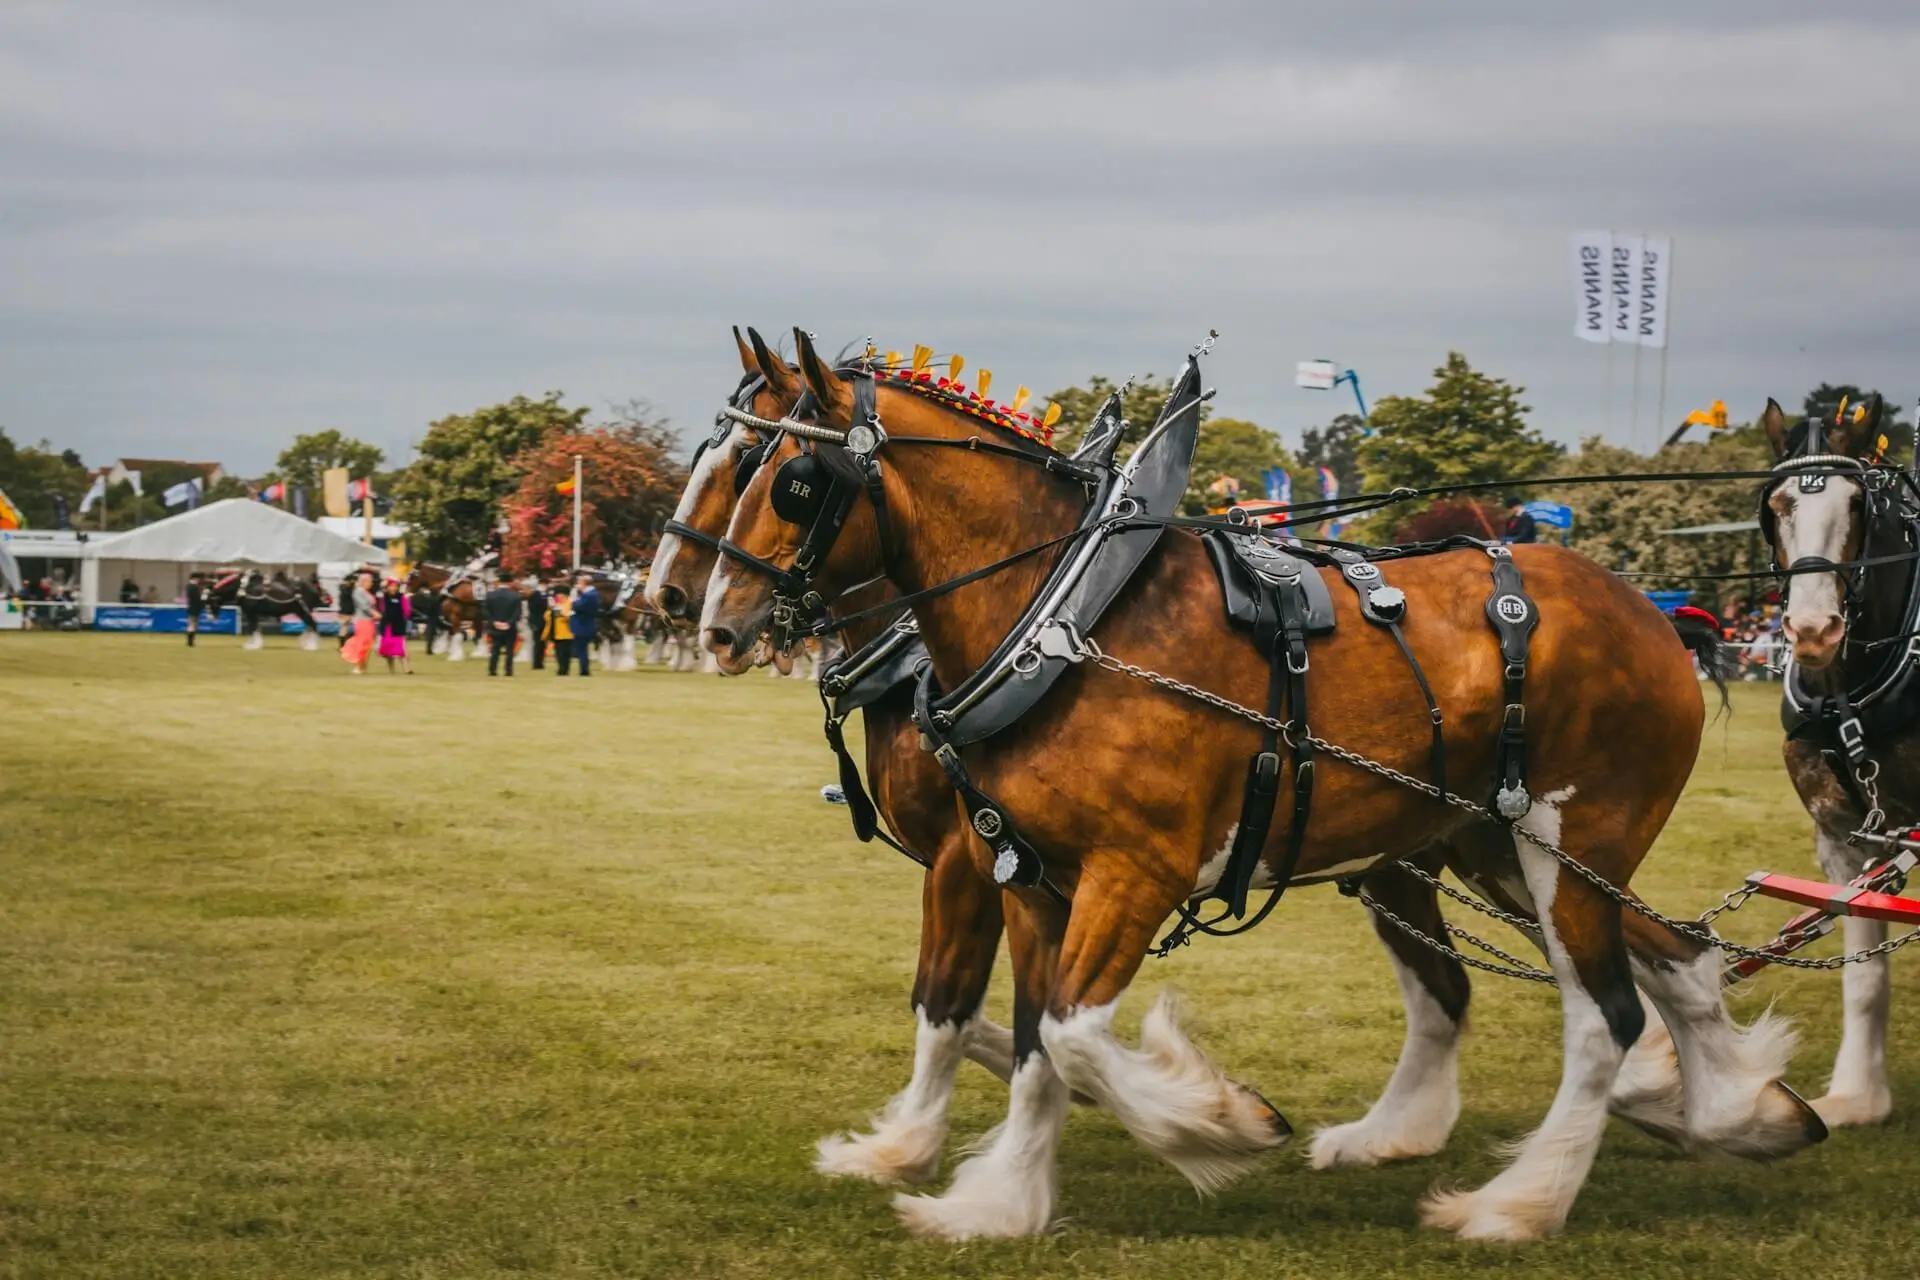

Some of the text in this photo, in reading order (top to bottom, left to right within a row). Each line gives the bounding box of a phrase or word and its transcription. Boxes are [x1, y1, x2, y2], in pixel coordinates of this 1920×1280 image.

[789, 479, 812, 498] HR
[1502, 602, 1522, 615] HR
[979, 815, 998, 832] HR
